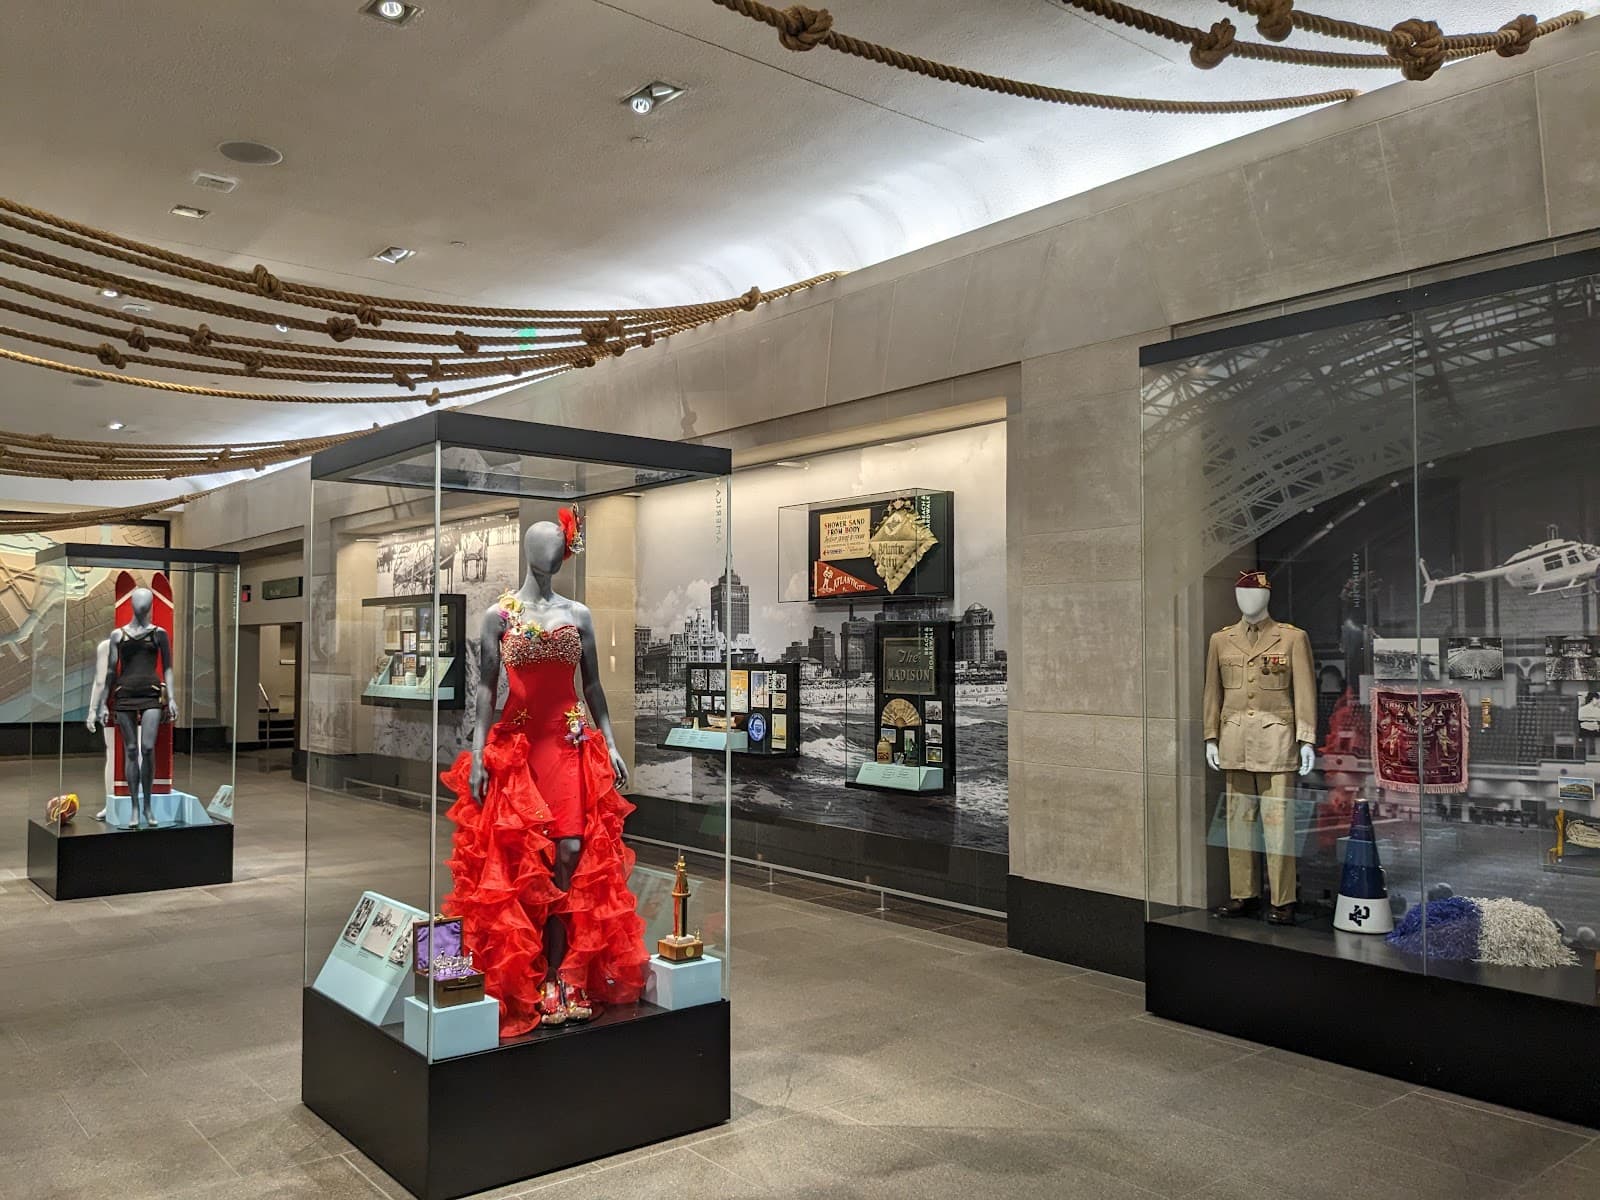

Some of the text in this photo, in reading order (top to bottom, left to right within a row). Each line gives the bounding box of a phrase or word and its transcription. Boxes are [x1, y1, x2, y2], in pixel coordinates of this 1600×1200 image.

[824, 517, 865, 529] SHOWER SAND
[827, 526, 860, 536] FROM BODY
[898, 649, 919, 663] The
[887, 668, 930, 681] MADISON
